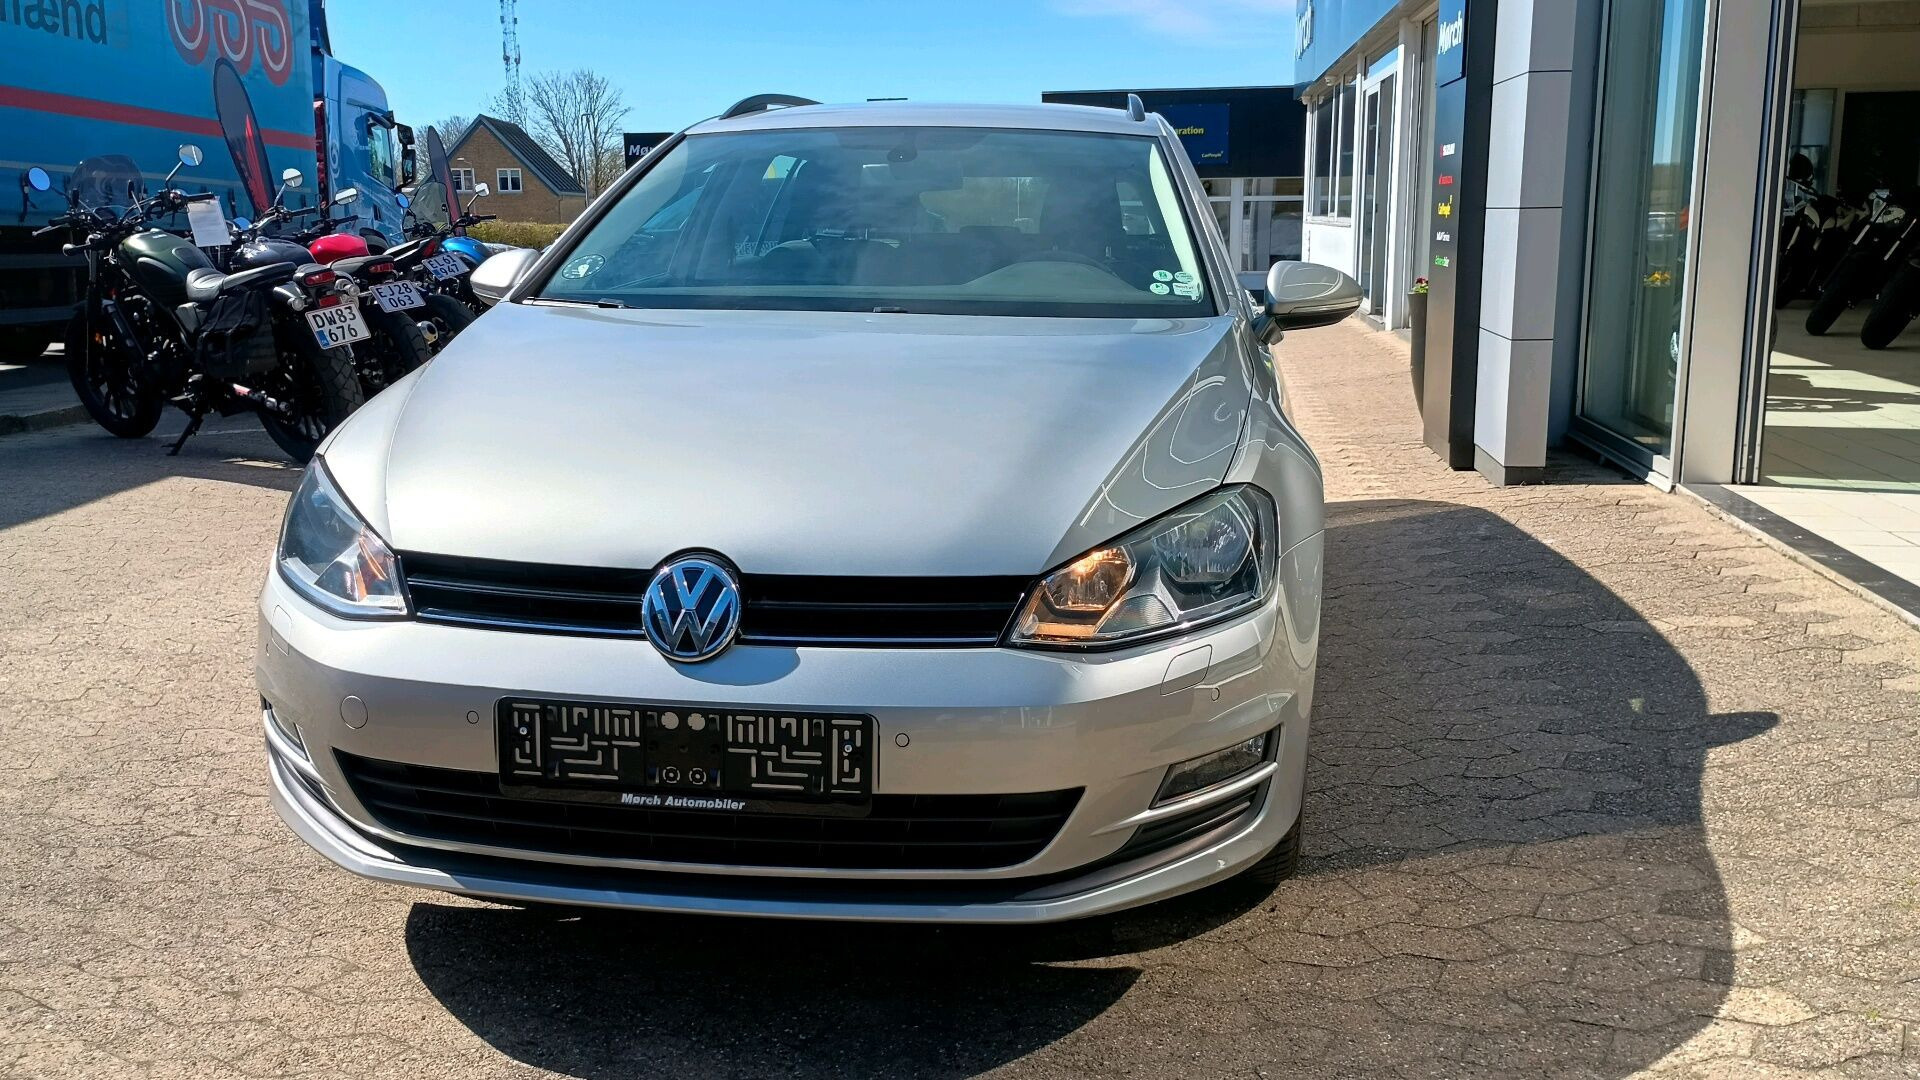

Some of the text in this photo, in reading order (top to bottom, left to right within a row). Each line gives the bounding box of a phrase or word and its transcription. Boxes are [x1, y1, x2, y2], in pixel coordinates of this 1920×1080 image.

[427, 253, 457, 269] EL61
[440, 264, 460, 276] 947
[376, 282, 413, 298] EJ28
[388, 294, 415, 308] 063
[311, 306, 357, 329] DW83
[328, 324, 358, 343] 676
[621, 793, 746, 810] Mørch Automobiler
